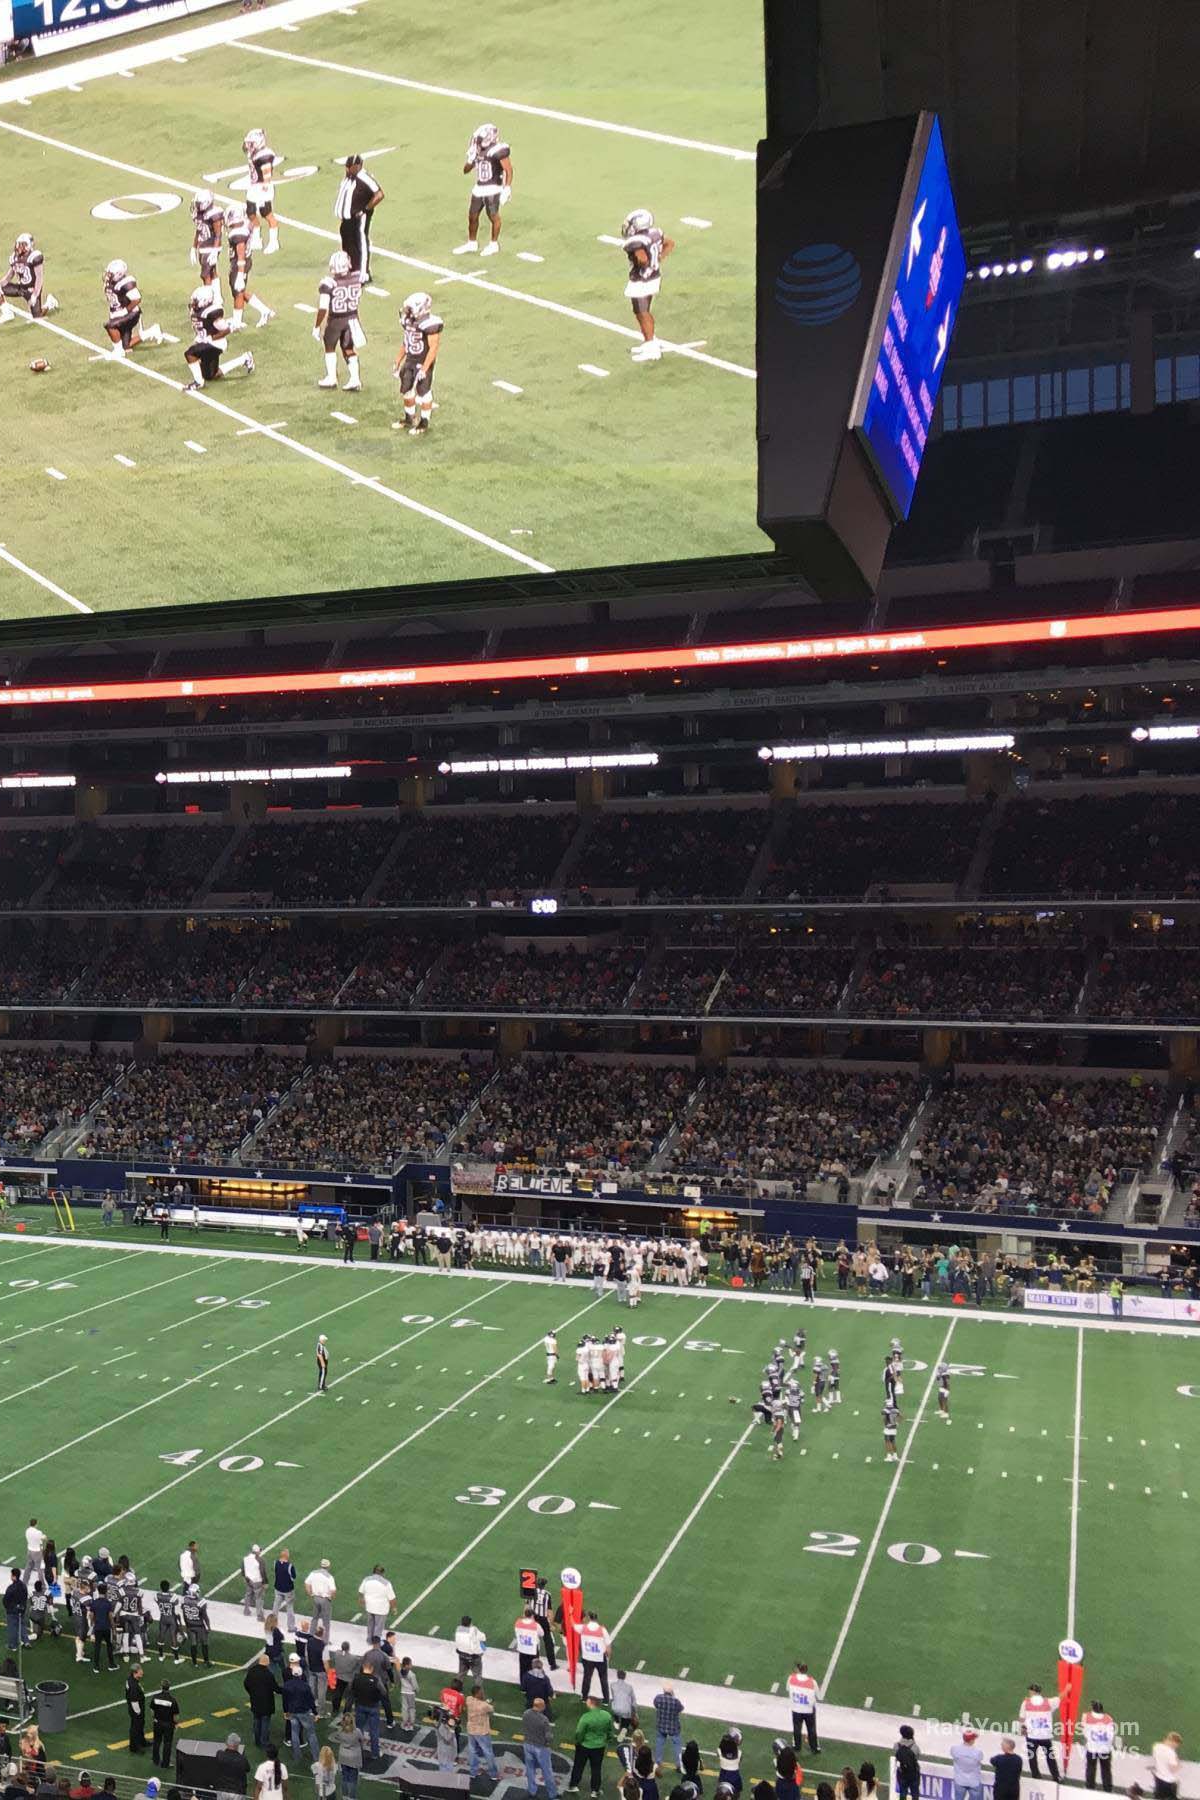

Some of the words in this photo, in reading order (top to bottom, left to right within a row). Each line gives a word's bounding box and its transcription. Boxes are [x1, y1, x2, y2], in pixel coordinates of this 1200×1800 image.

[497, 1174, 573, 1194] BELIEVE
[157, 1448, 265, 1474] 40
[455, 1485, 577, 1516] 30
[803, 1532, 942, 1566] 20
[522, 1571, 536, 1588] 2
